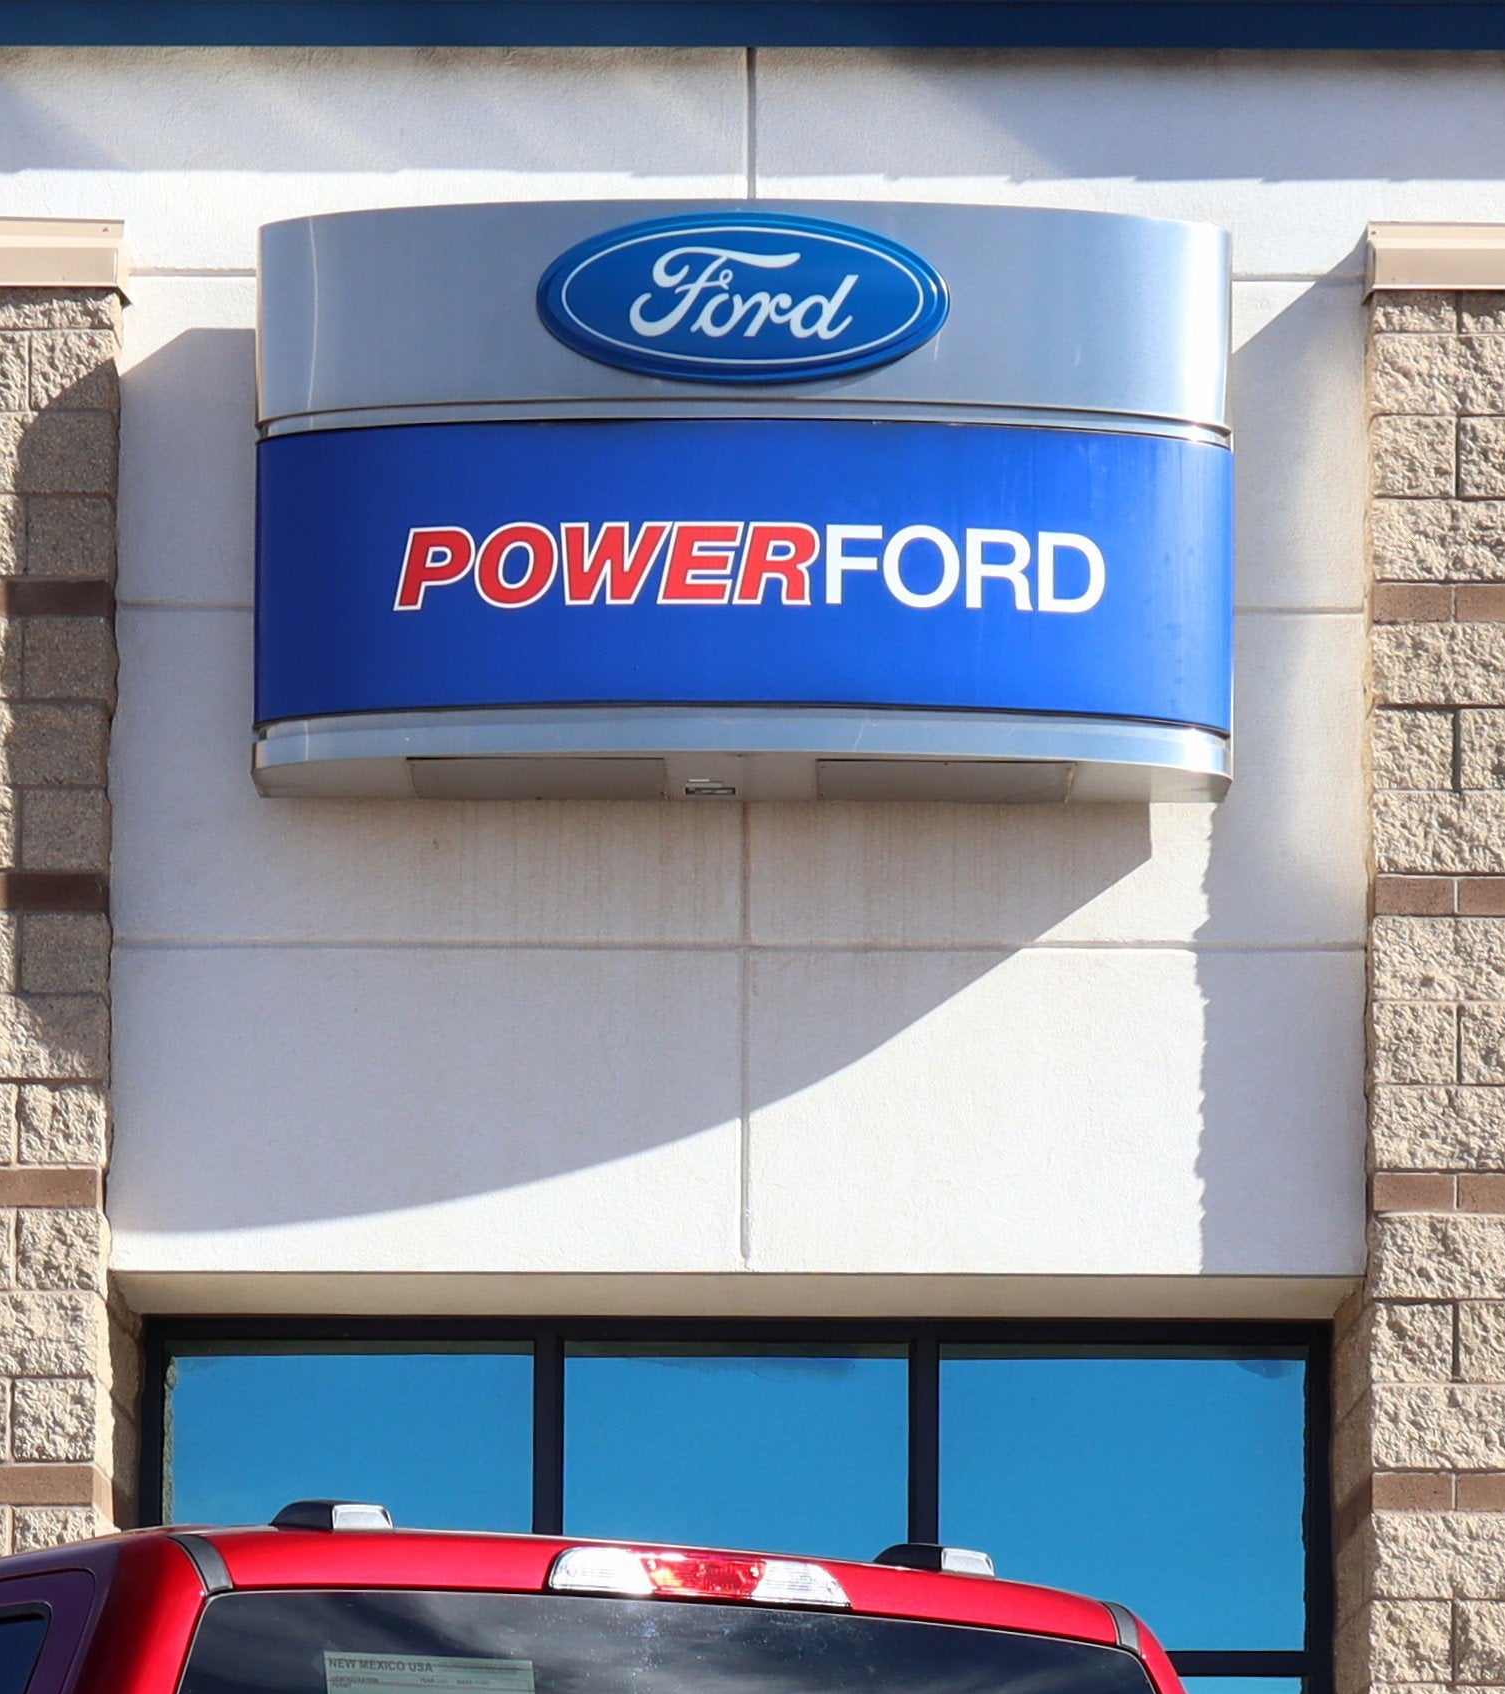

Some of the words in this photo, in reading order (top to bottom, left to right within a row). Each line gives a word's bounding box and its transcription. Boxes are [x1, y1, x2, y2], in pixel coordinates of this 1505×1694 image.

[629, 246, 857, 341] Ford
[393, 520, 1106, 613] POWERFORD
[329, 1658, 357, 1670] NEW
[359, 1660, 406, 1672] MEXICO
[407, 1661, 433, 1673] USA
